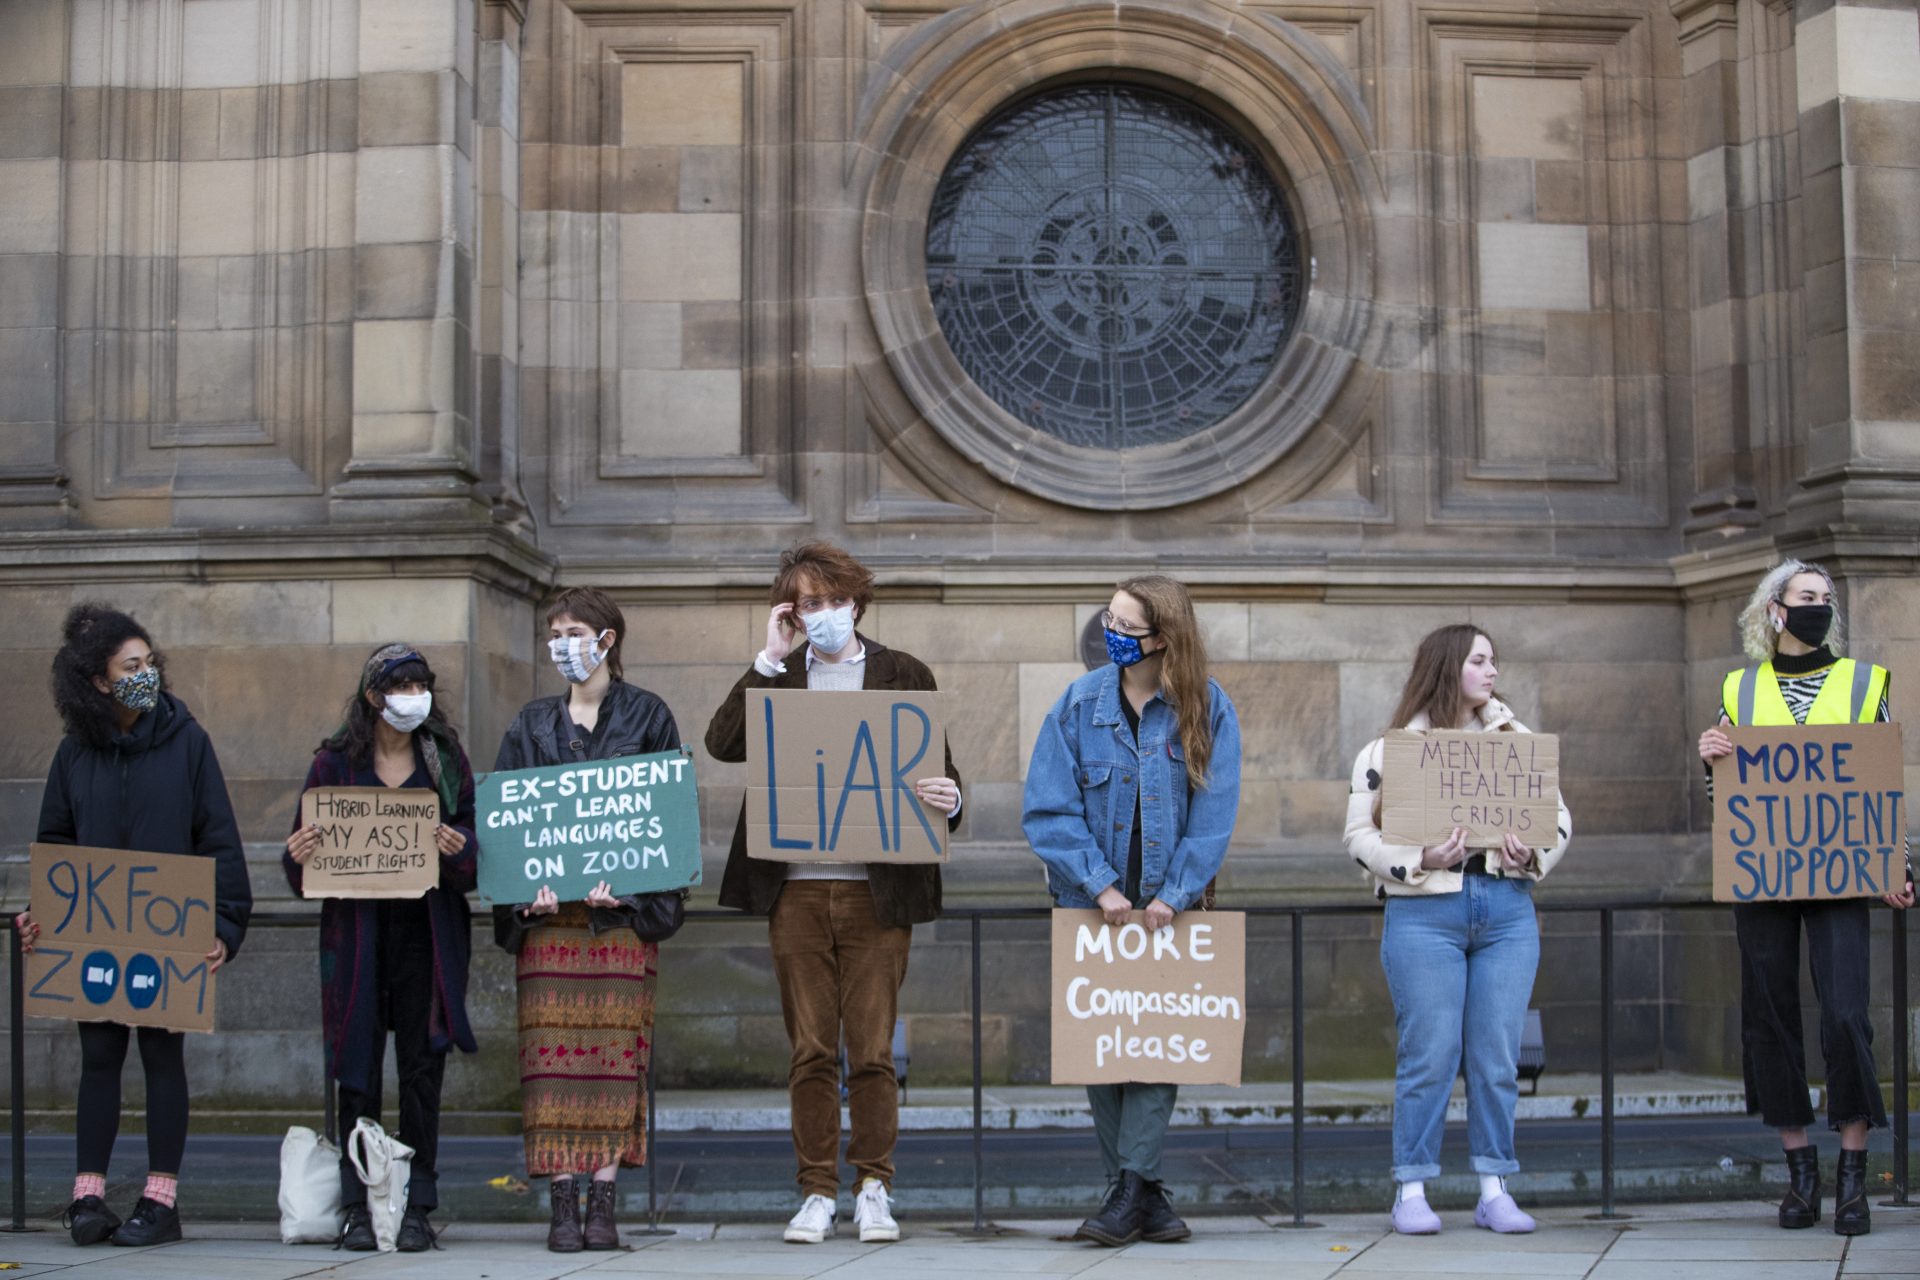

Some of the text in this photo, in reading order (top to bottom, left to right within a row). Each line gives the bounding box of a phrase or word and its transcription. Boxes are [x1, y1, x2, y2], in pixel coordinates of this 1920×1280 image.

[1420, 740, 1545, 773] MENTAL
[1736, 742, 1855, 784] MORE
[500, 759, 688, 802] EX-STUDENT
[1440, 771, 1542, 799] HEALTH
[316, 793, 435, 819] HYBRID LEARNING
[487, 791, 652, 828] CAN'T LEARN
[1451, 805, 1531, 831] CRISIS
[1728, 791, 1903, 847] STUDENT
[319, 822, 419, 850] MY ASS!
[524, 816, 663, 848] LANGUAGES
[312, 853, 426, 870] STUDENT RIGHTS
[524, 844, 669, 880] ON ZOOM
[1732, 847, 1894, 900] SUPPORT
[47, 861, 210, 937] 9K For
[1075, 923, 1215, 963] MORE
[29, 947, 208, 1014] ZOOM
[1066, 976, 1241, 1025] Compassion
[1096, 1025, 1211, 1068] please
